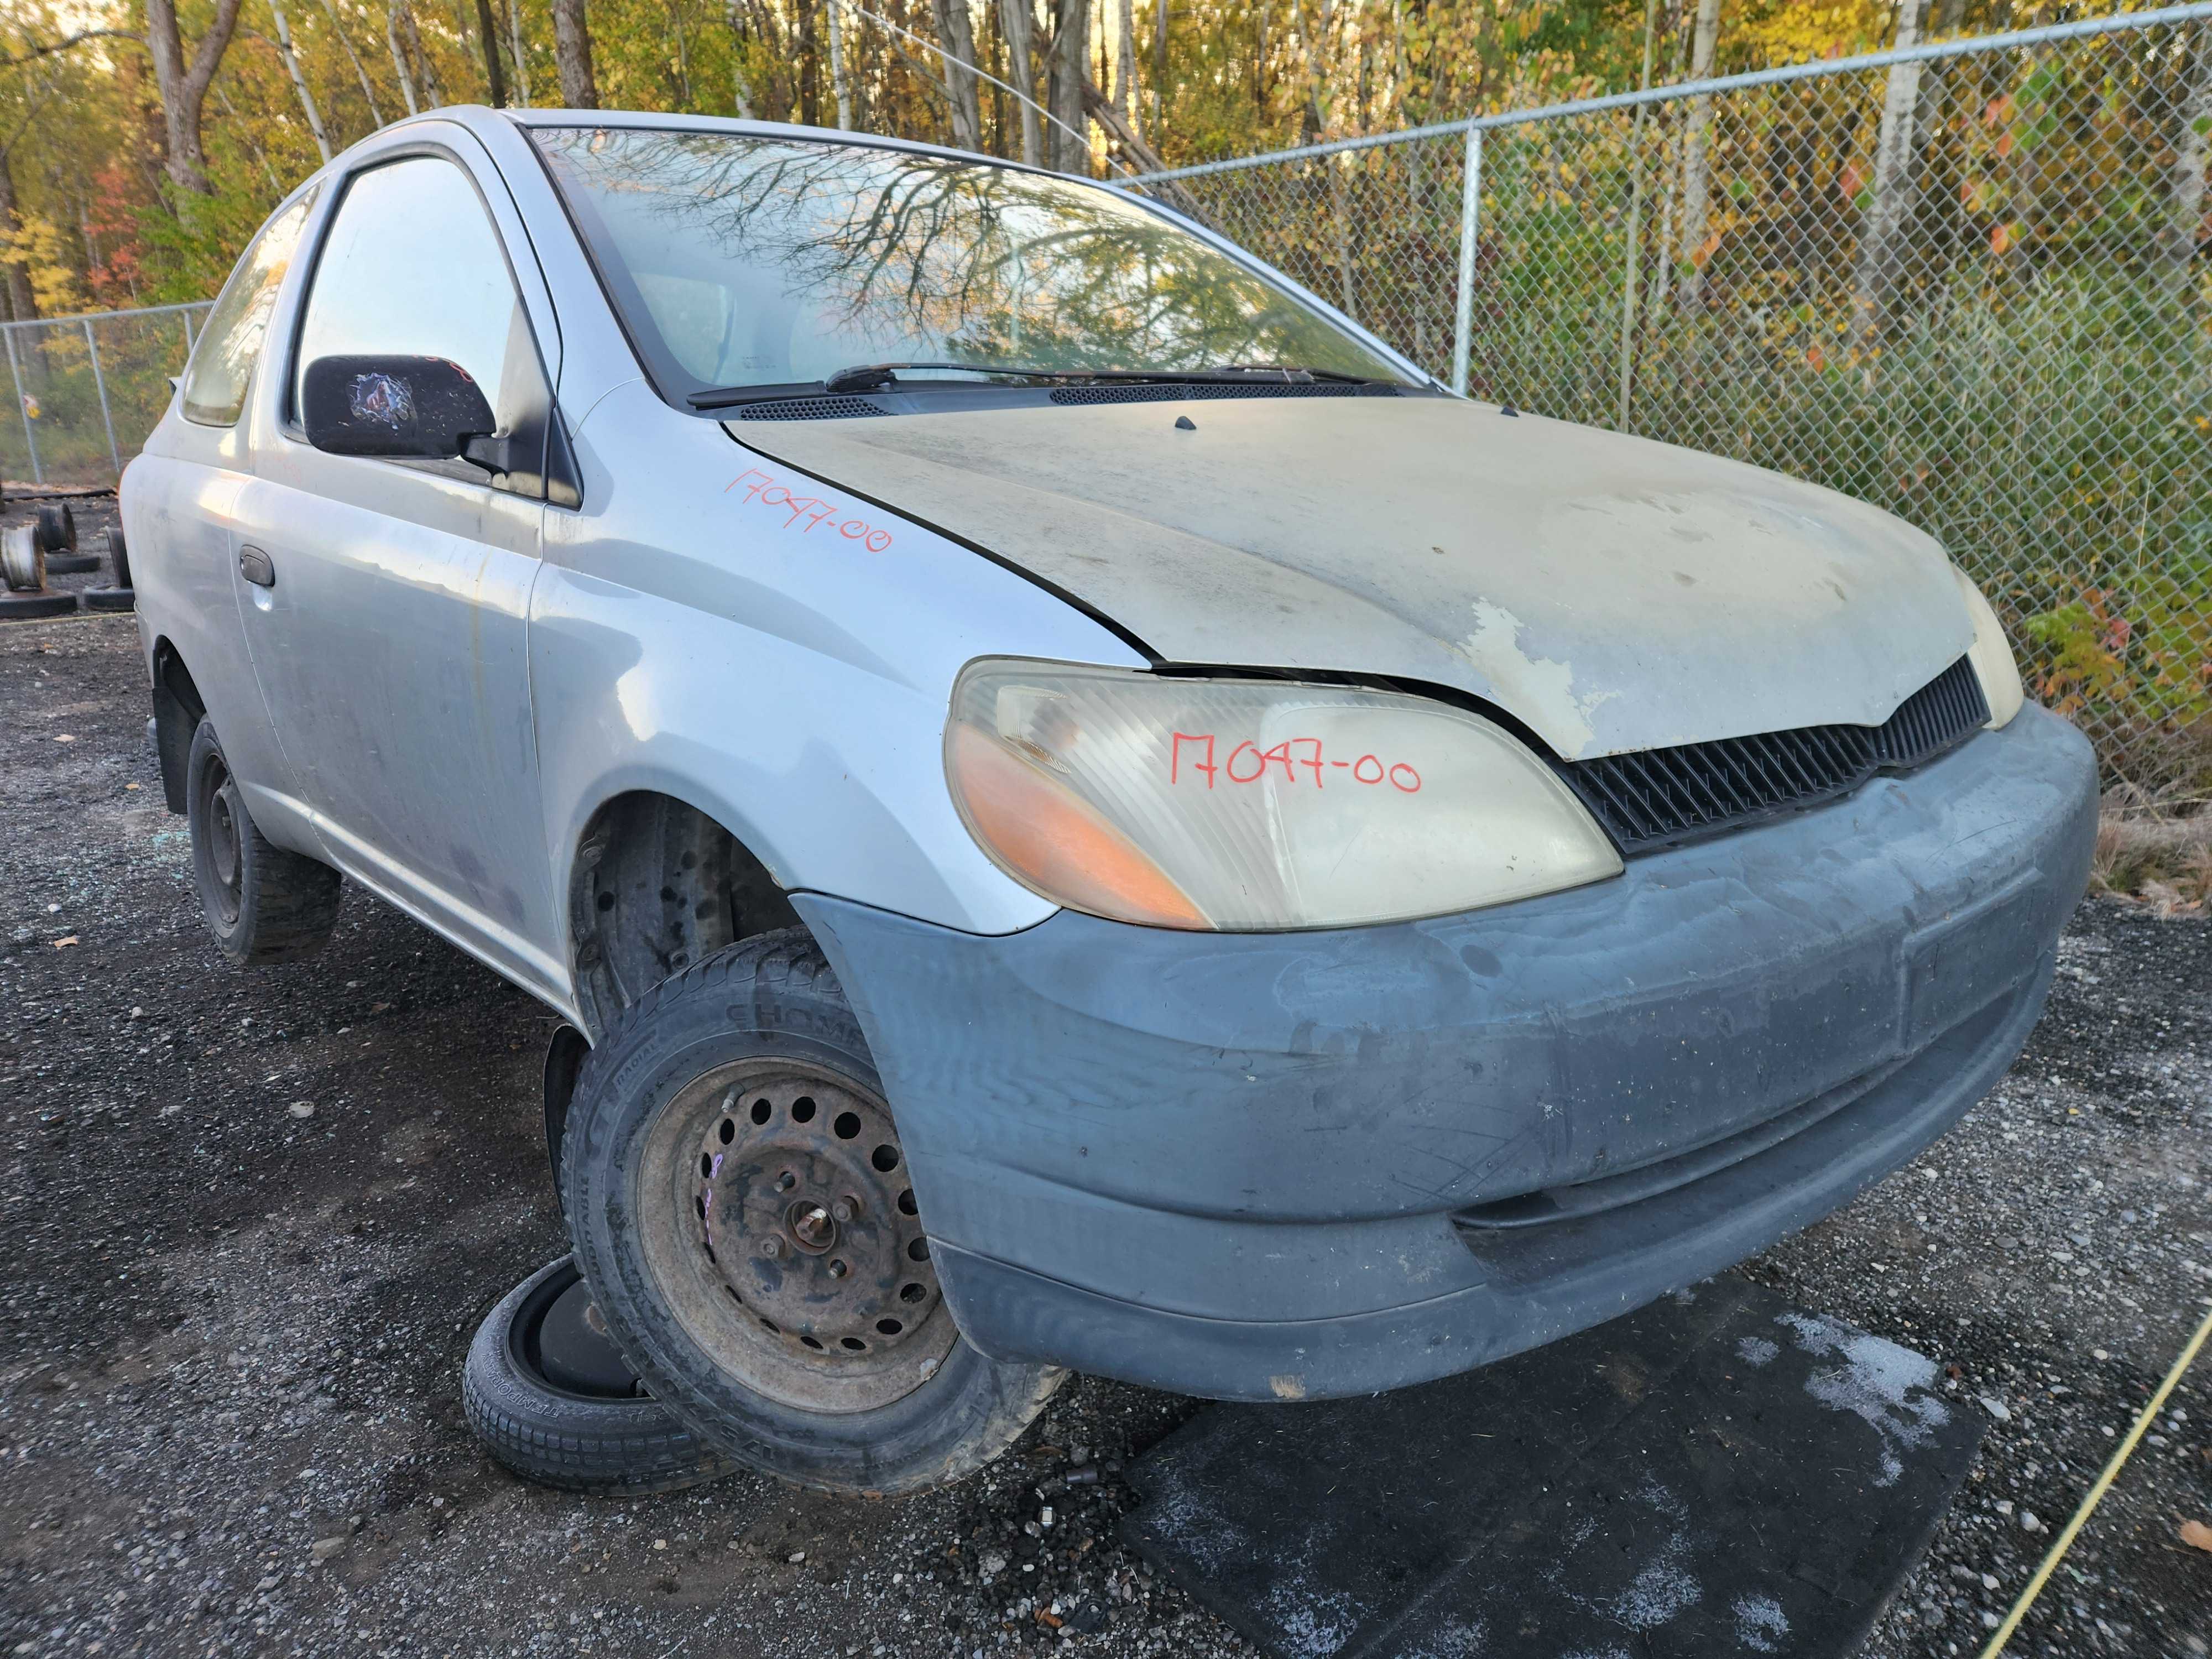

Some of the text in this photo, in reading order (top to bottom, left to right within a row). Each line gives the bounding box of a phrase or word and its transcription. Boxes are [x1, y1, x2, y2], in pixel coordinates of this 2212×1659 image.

[724, 468, 892, 552] 17047-00
[1172, 732, 1421, 792] 17047-00
[481, 1353, 561, 1418] TEMPORARY
